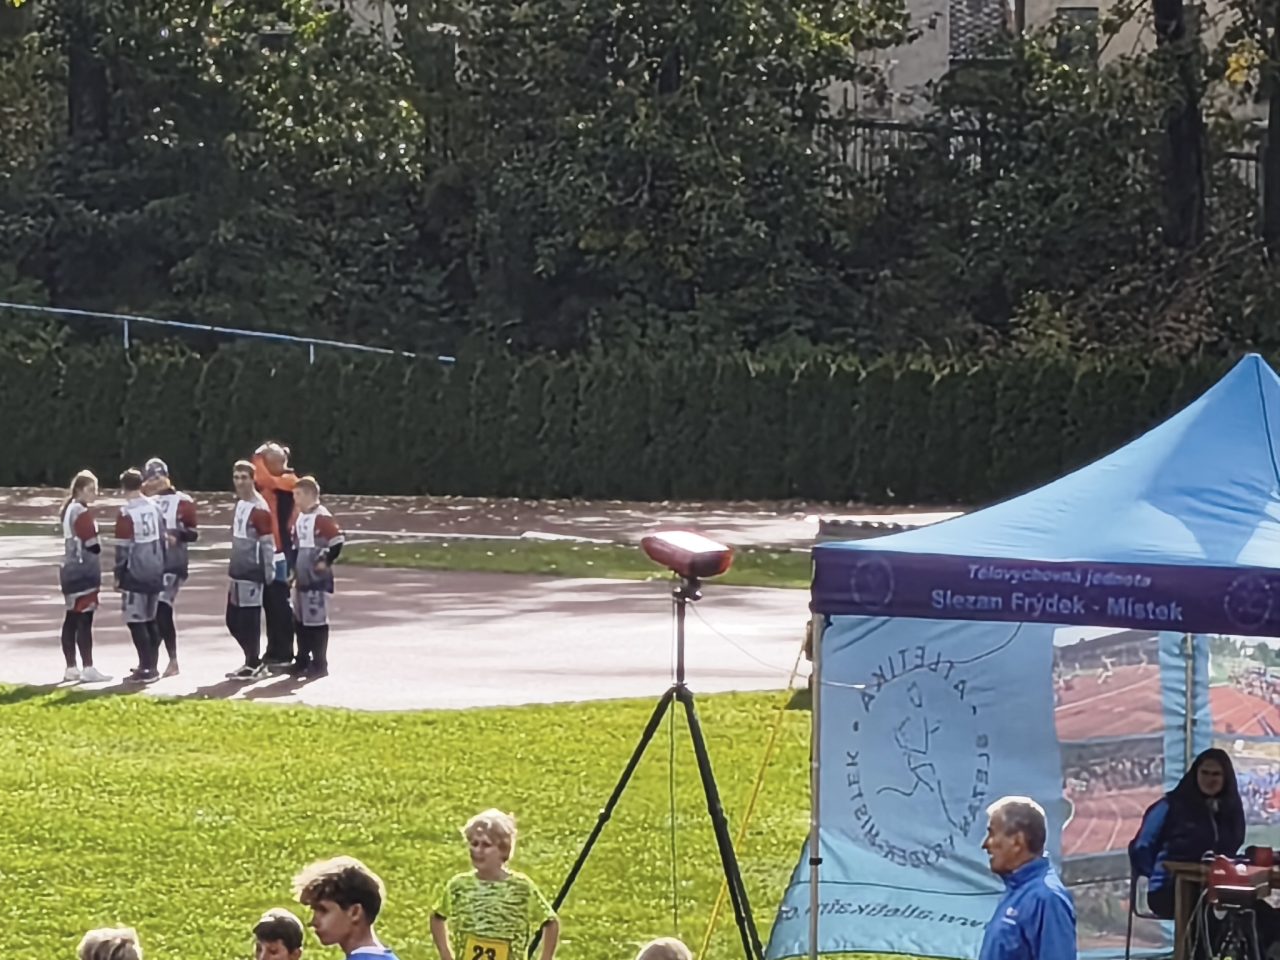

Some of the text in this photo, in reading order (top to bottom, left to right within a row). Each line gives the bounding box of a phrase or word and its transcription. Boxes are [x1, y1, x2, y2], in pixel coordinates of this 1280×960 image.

[931, 589, 1003, 611] Slezan
[1011, 592, 1085, 617] Frýdek
[1107, 597, 1183, 621] Místek
